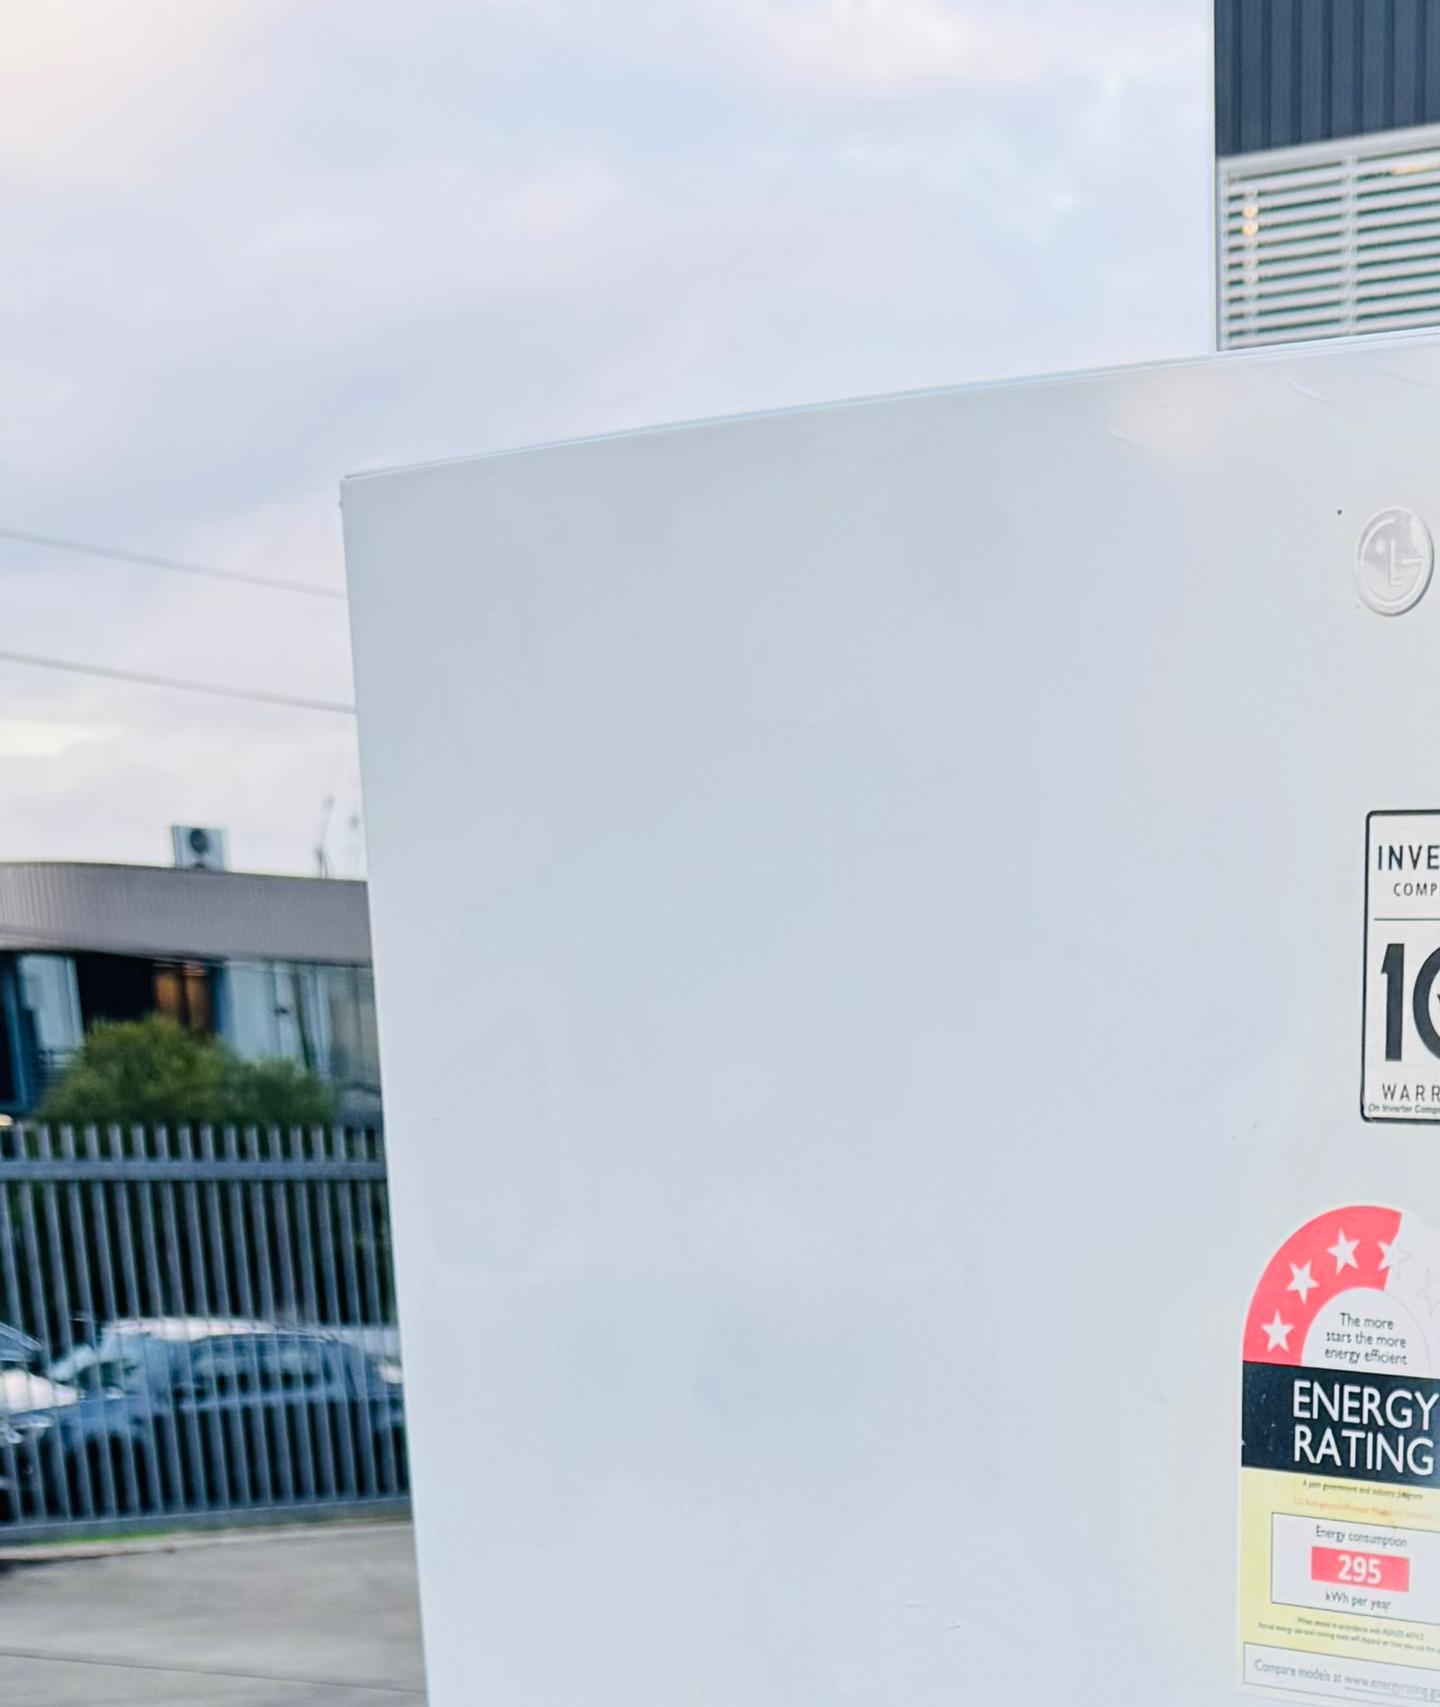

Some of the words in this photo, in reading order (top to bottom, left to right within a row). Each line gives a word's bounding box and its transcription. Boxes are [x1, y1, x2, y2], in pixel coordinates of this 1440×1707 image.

[1340, 1312, 1360, 1327] The
[1363, 1318, 1394, 1330] more
[1326, 1331, 1352, 1344] stars
[1355, 1331, 1373, 1345] the
[1376, 1336, 1406, 1348] more
[1325, 1348, 1360, 1364] energy
[1364, 1349, 1408, 1365] efficient
[1293, 1379, 1440, 1431] ENERGY
[1294, 1423, 1434, 1476] RATING
[1316, 1524, 1345, 1543] Energy
[1348, 1532, 1408, 1549] consumption
[1338, 1554, 1382, 1584] 295
[1325, 1590, 1349, 1604] kWh
[1351, 1596, 1368, 1607] per
[1370, 1599, 1392, 1612] year
[1254, 1658, 1296, 1678] Compare
[1298, 1667, 1331, 1682] models
[1333, 1672, 1343, 1684] at
